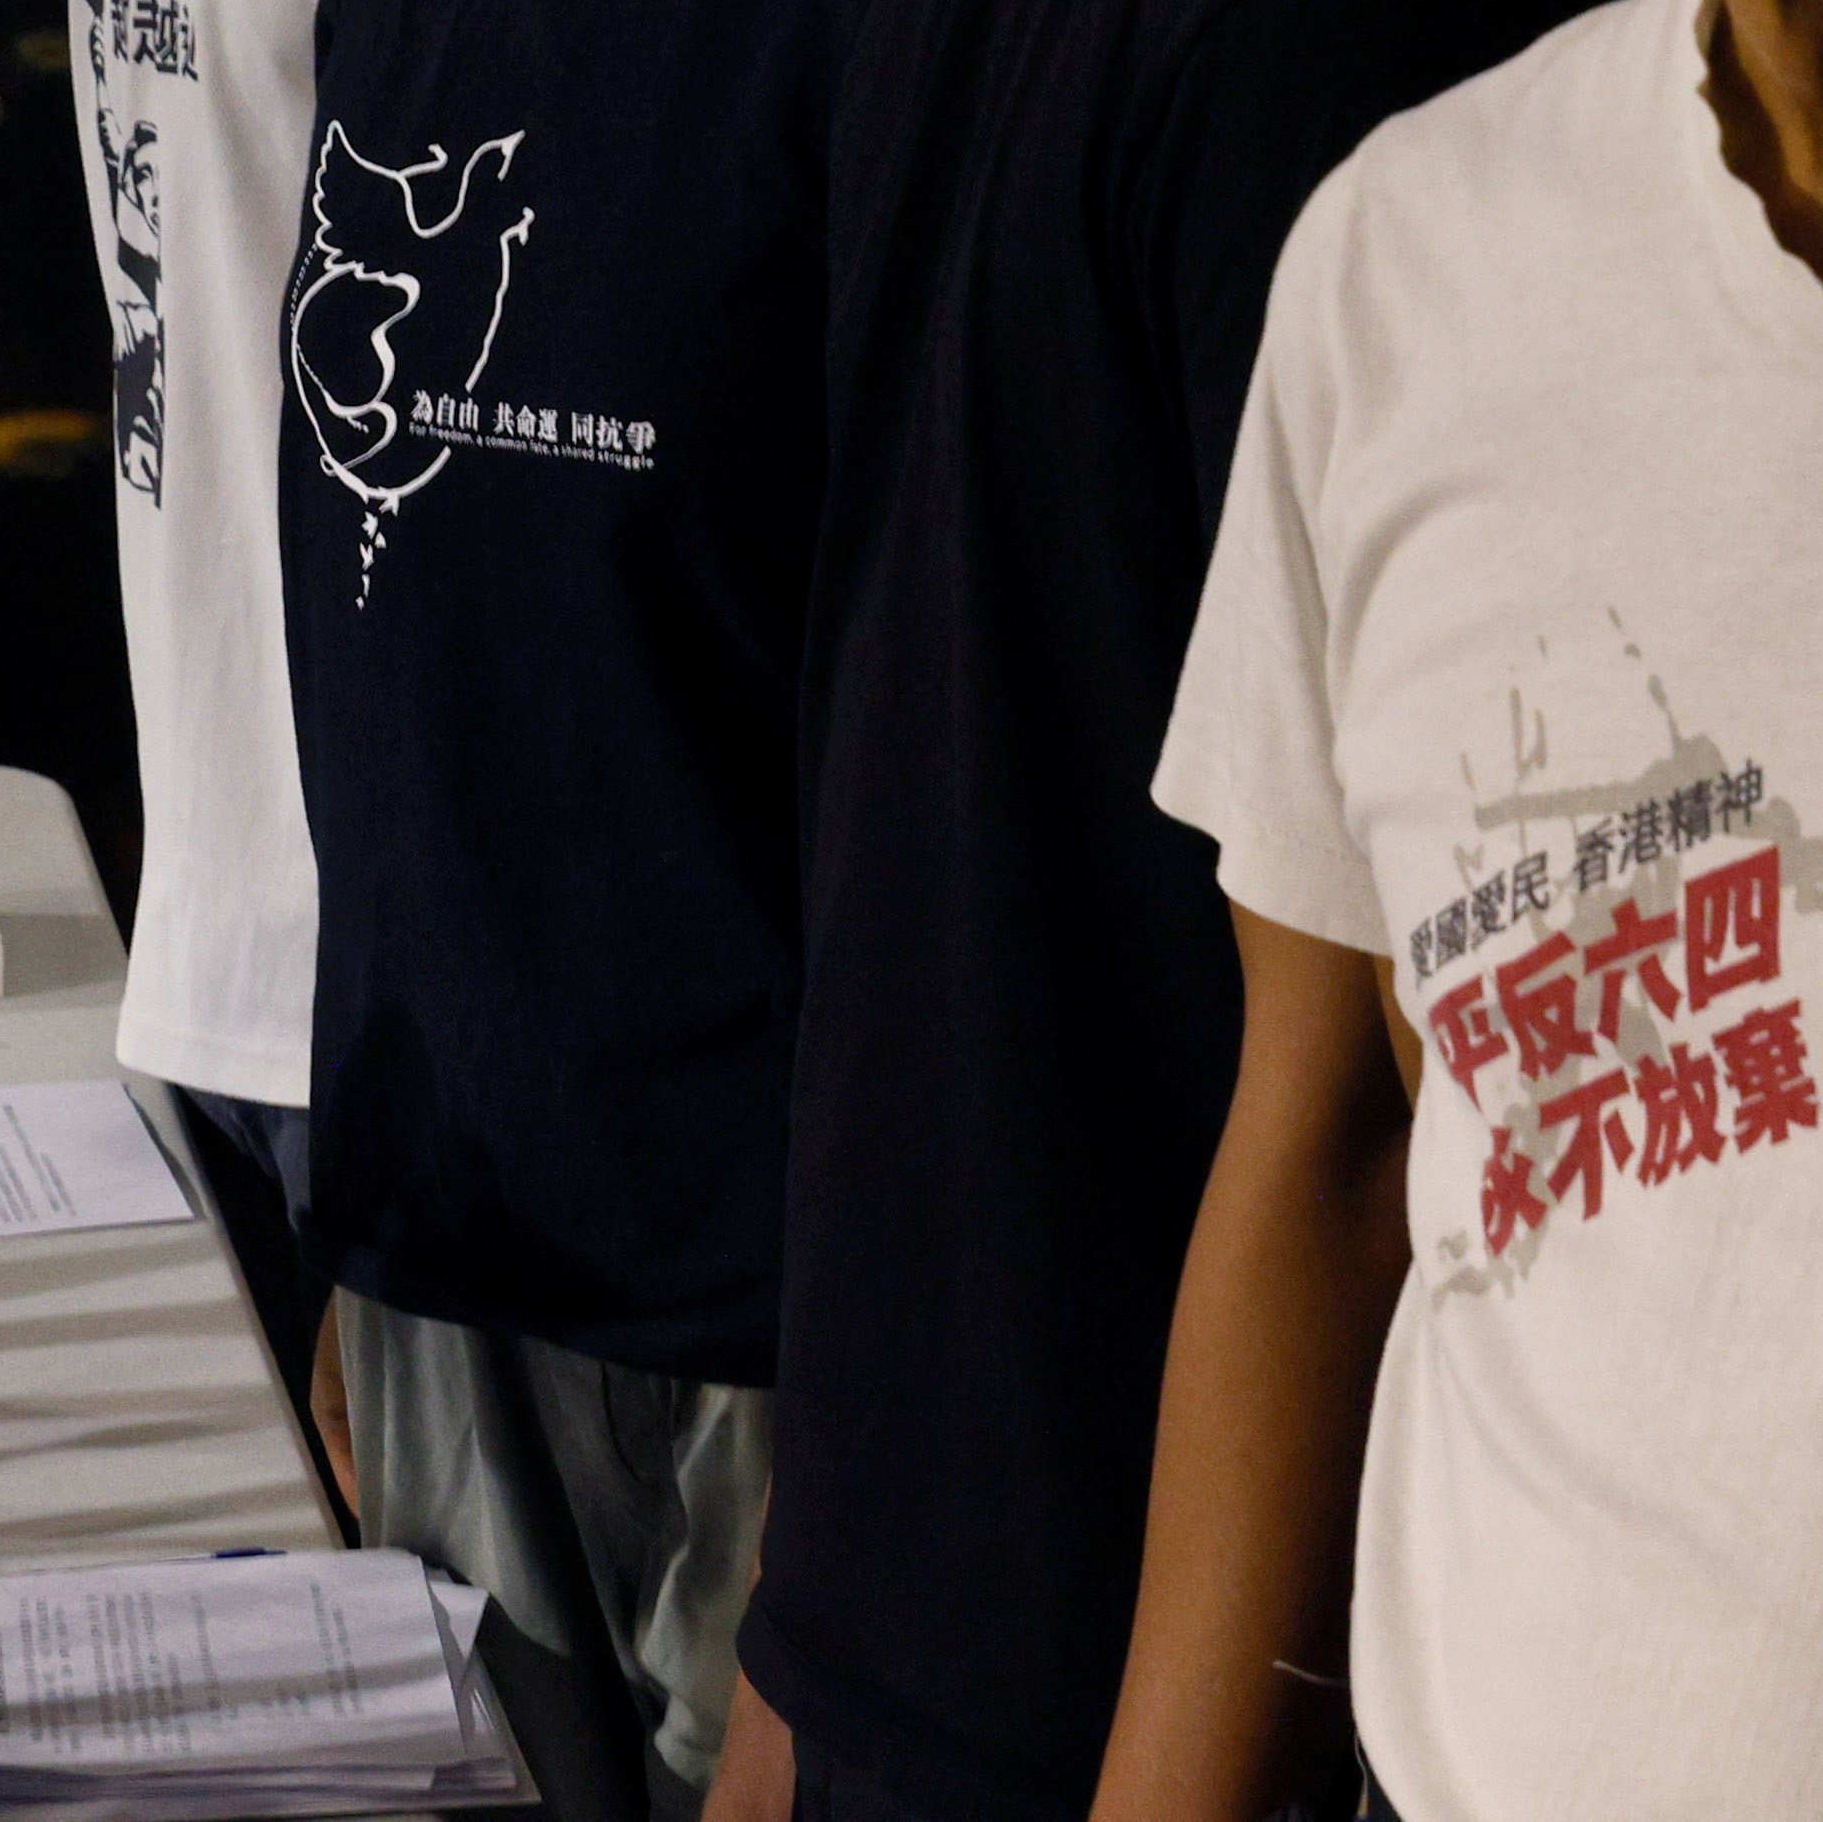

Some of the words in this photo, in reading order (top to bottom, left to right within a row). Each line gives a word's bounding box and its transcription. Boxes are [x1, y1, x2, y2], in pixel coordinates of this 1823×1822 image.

[409, 422, 427, 436] For
[485, 434, 528, 451] common
[561, 442, 595, 462] shared
[597, 448, 655, 471] struggle
[410, 389, 479, 430] 為自由
[493, 401, 559, 443] 共命運
[1573, 759, 1763, 891] 香港精神
[1429, 846, 1781, 1112] 平反六四
[1481, 997, 1819, 1257] 永不放棄
